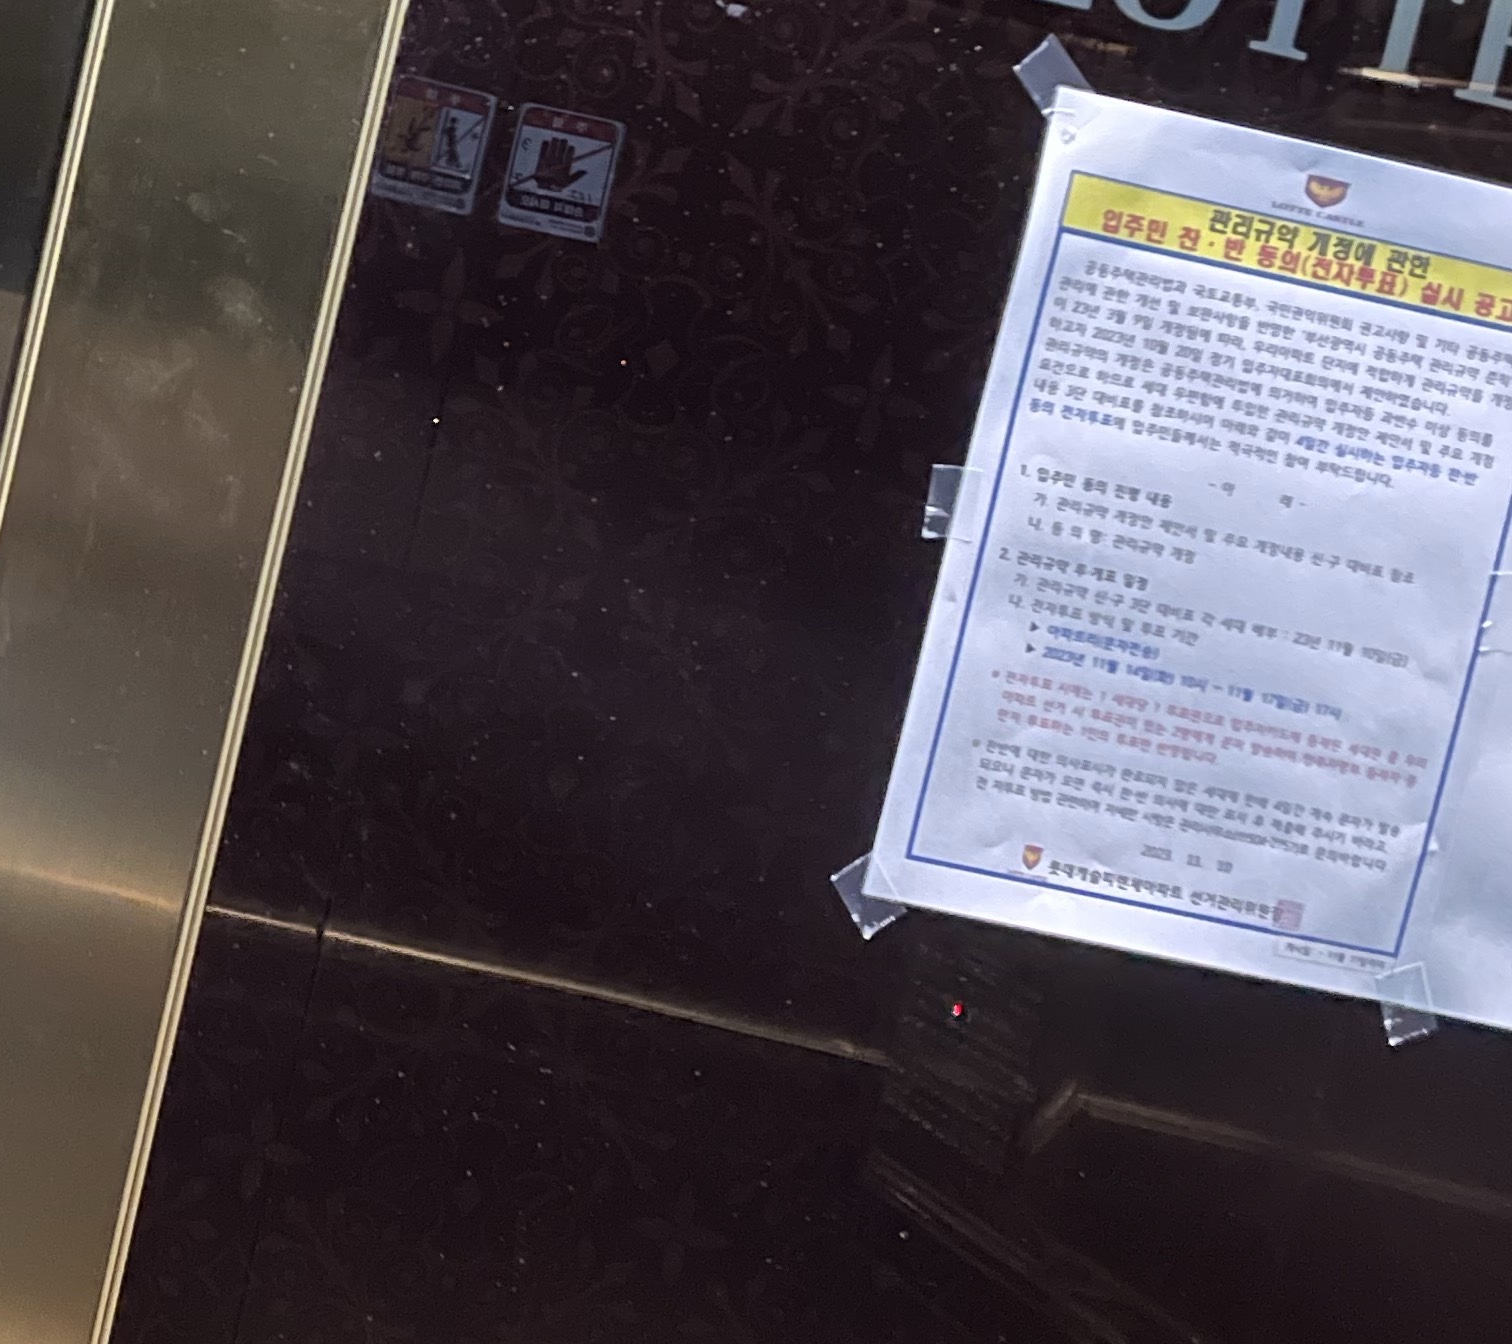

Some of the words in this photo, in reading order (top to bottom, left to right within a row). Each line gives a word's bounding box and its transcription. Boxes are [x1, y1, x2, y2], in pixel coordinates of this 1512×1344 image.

[1206, 207, 1301, 252] 관리규약
[1304, 229, 1378, 269] 개정에
[1383, 246, 1433, 281] 관한
[1270, 199, 1314, 217] LOTTE
[1314, 209, 1365, 228] CASTLE
[1098, 207, 1170, 246] 입주민
[1253, 242, 1411, 300] 동의(전자투표)
[1417, 279, 1465, 313] 실시
[1471, 291, 1512, 325] 공고
